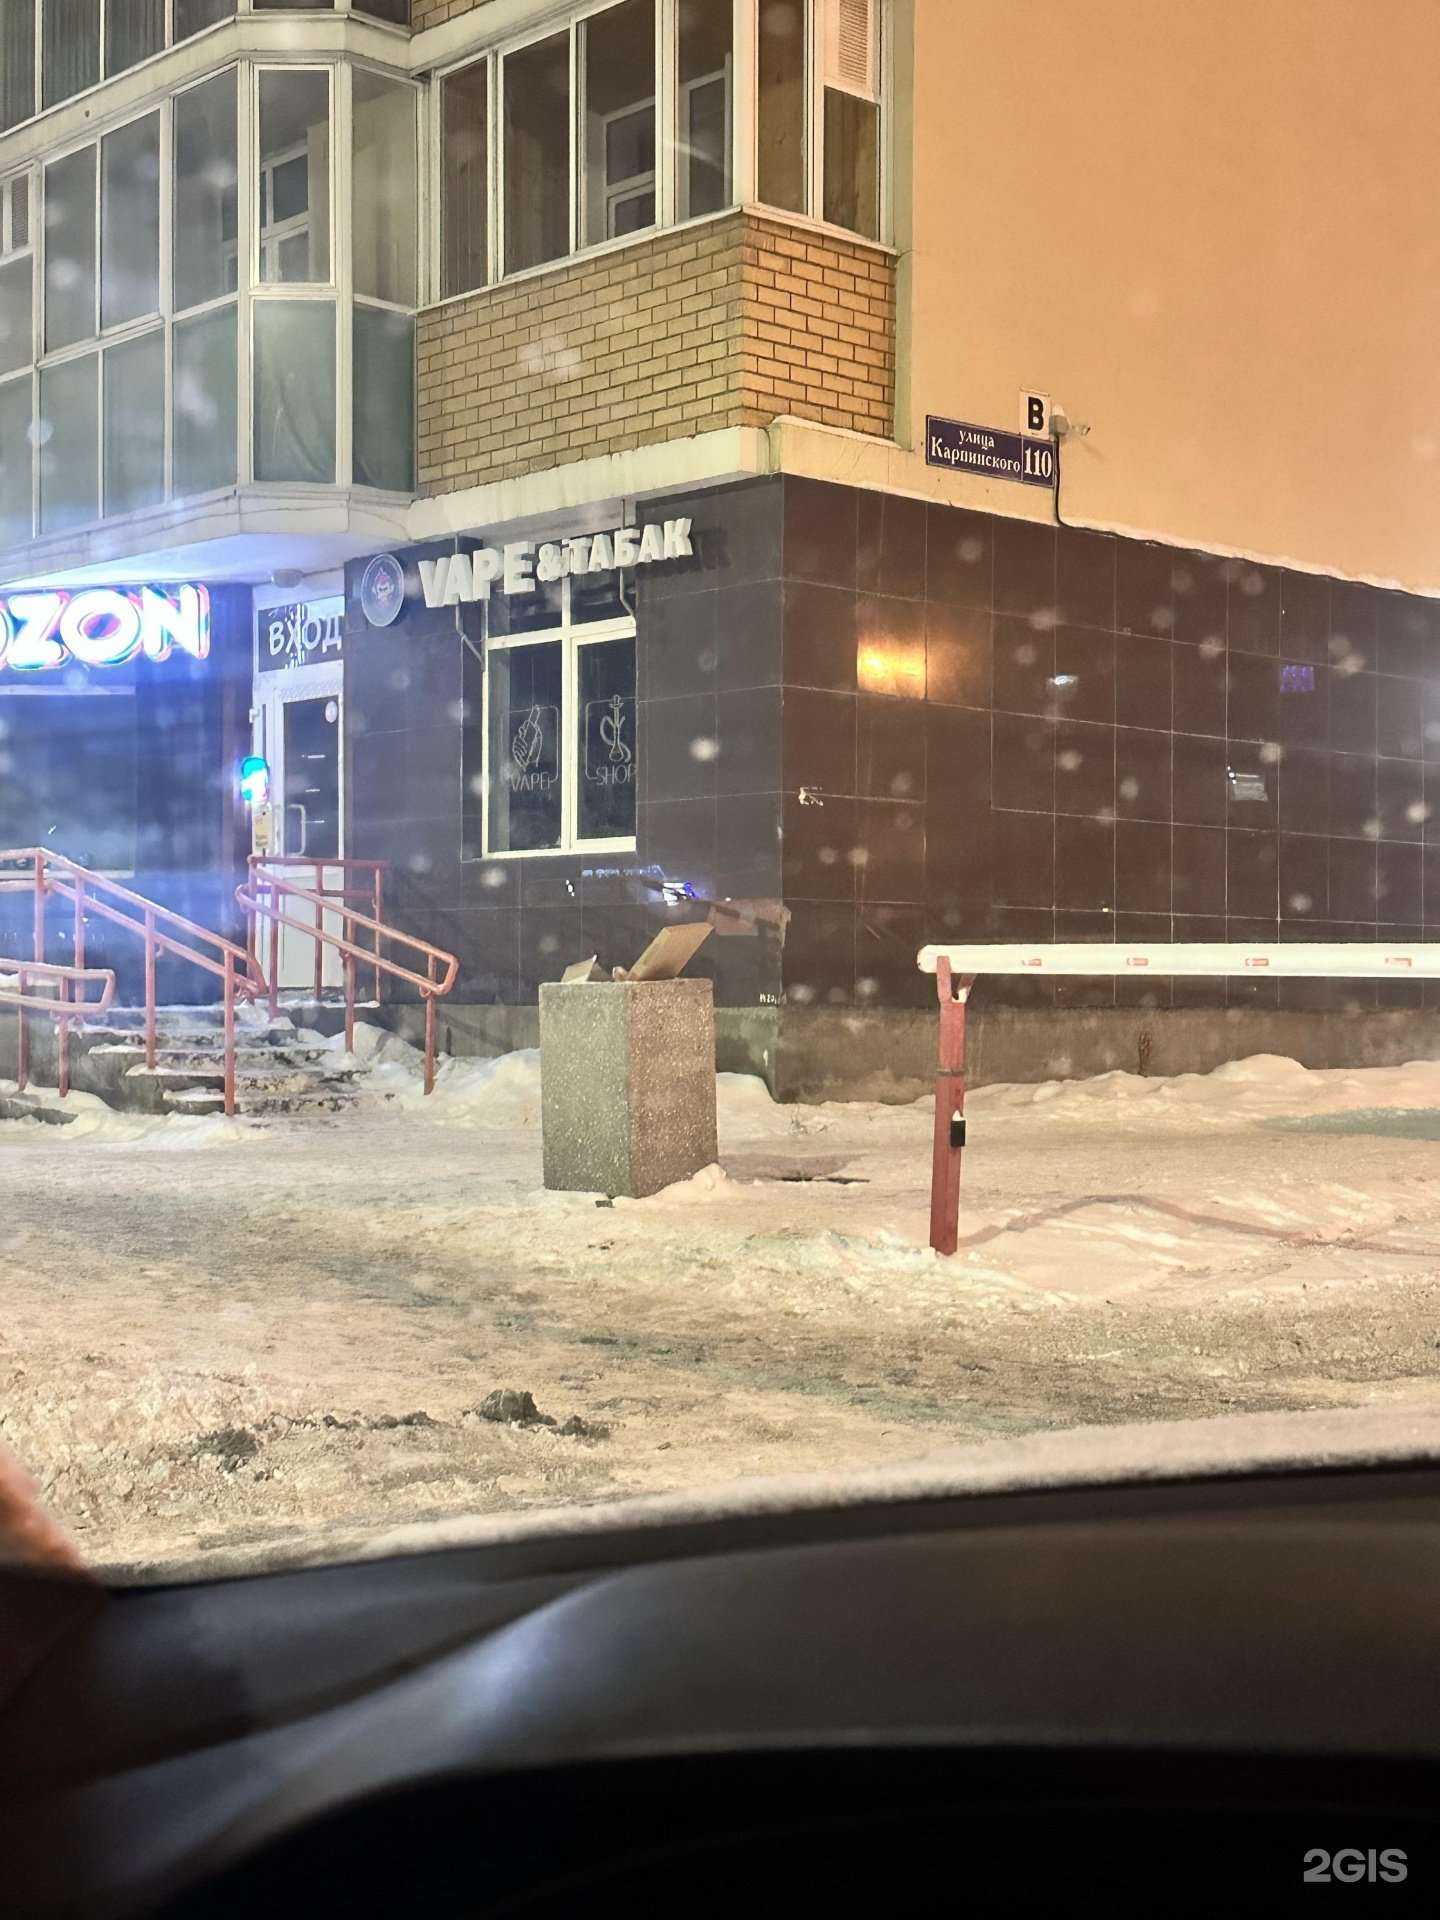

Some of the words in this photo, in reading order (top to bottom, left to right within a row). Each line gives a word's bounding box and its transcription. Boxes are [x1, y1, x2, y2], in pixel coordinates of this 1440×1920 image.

[931, 436, 1021, 472] Карпинского
[1024, 447, 1053, 478] 110
[958, 430, 995, 450] улица
[418, 541, 536, 608] VAPE
[0, 583, 209, 671] ZON
[269, 614, 342, 656] ВХОД
